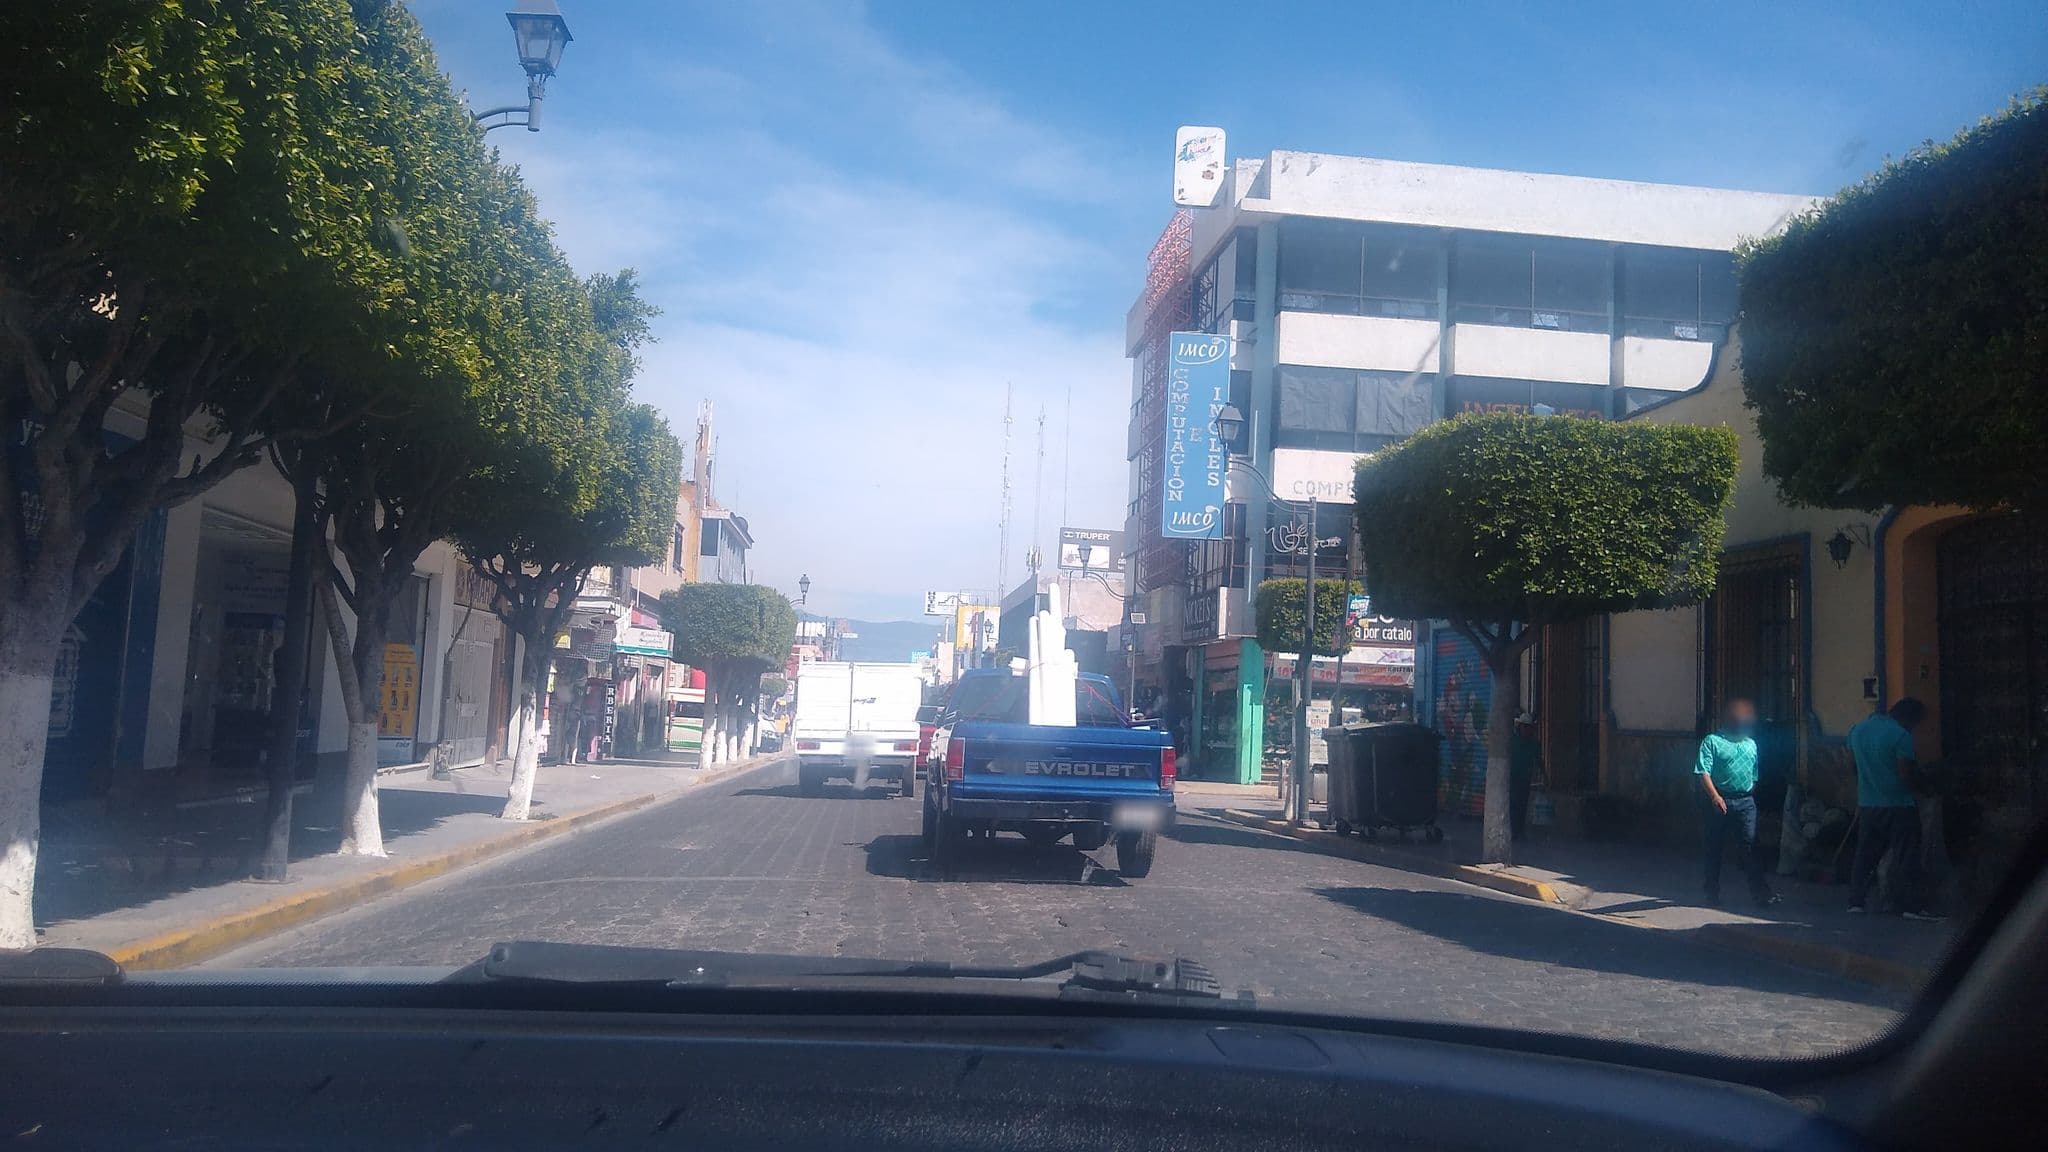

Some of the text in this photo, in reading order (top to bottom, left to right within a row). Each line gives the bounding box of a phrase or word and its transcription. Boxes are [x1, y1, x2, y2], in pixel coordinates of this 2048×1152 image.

[1178, 343, 1218, 357] IMCO
[1172, 511, 1213, 526] IMCO
[1074, 531, 1111, 541] TRUPER
[1364, 627, 1380, 640] por
[605, 687, 615, 743] RBERIA
[987, 761, 1135, 777] EVROLET
